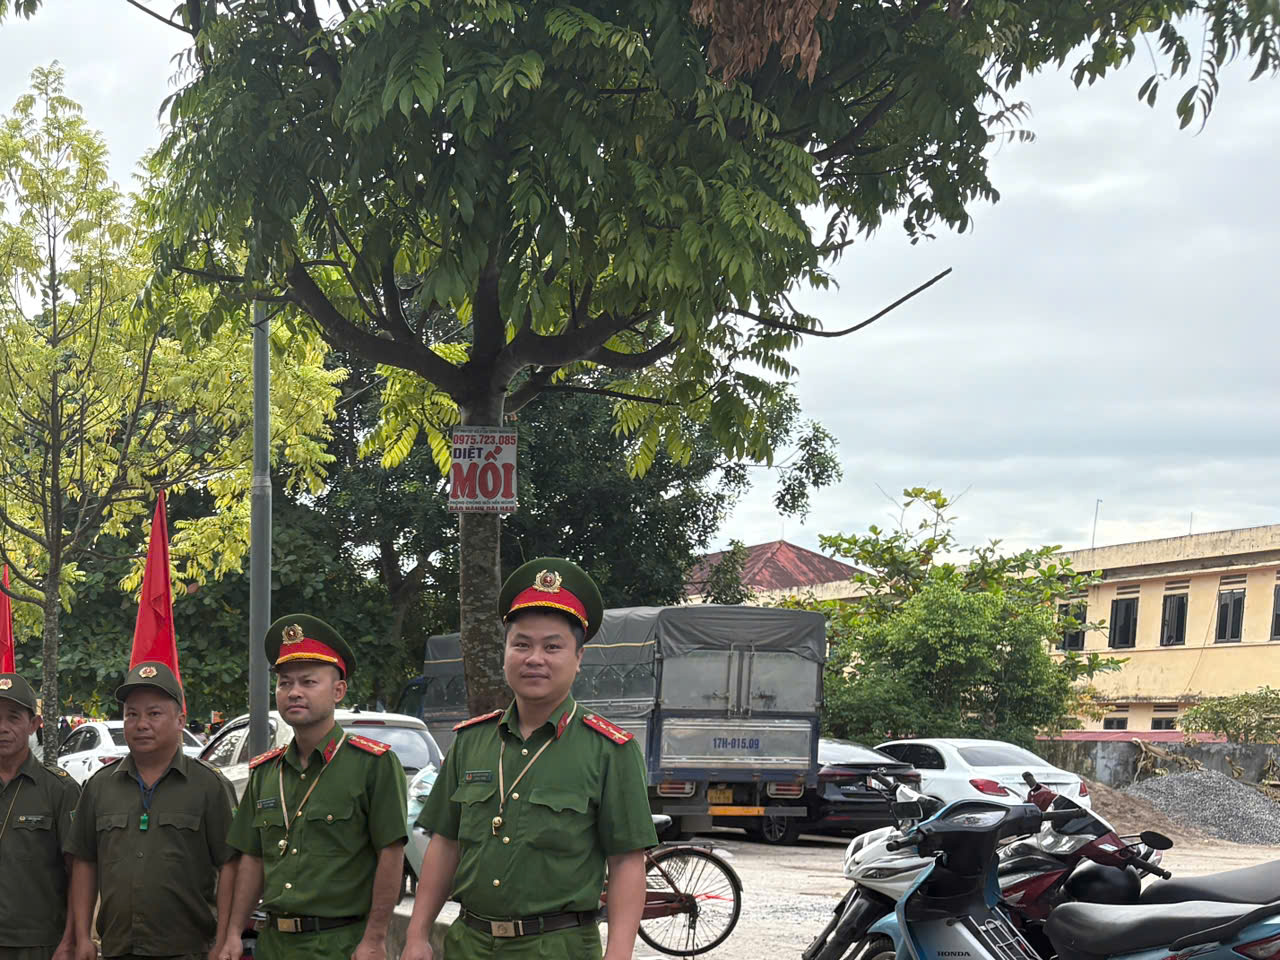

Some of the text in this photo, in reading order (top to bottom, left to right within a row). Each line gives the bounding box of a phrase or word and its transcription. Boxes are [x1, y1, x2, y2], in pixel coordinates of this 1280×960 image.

[453, 434, 516, 446] 0975.723.085
[453, 445, 483, 461] DIỆT
[450, 446, 515, 500] MỐI
[713, 737, 760, 750] 17H-015.09
